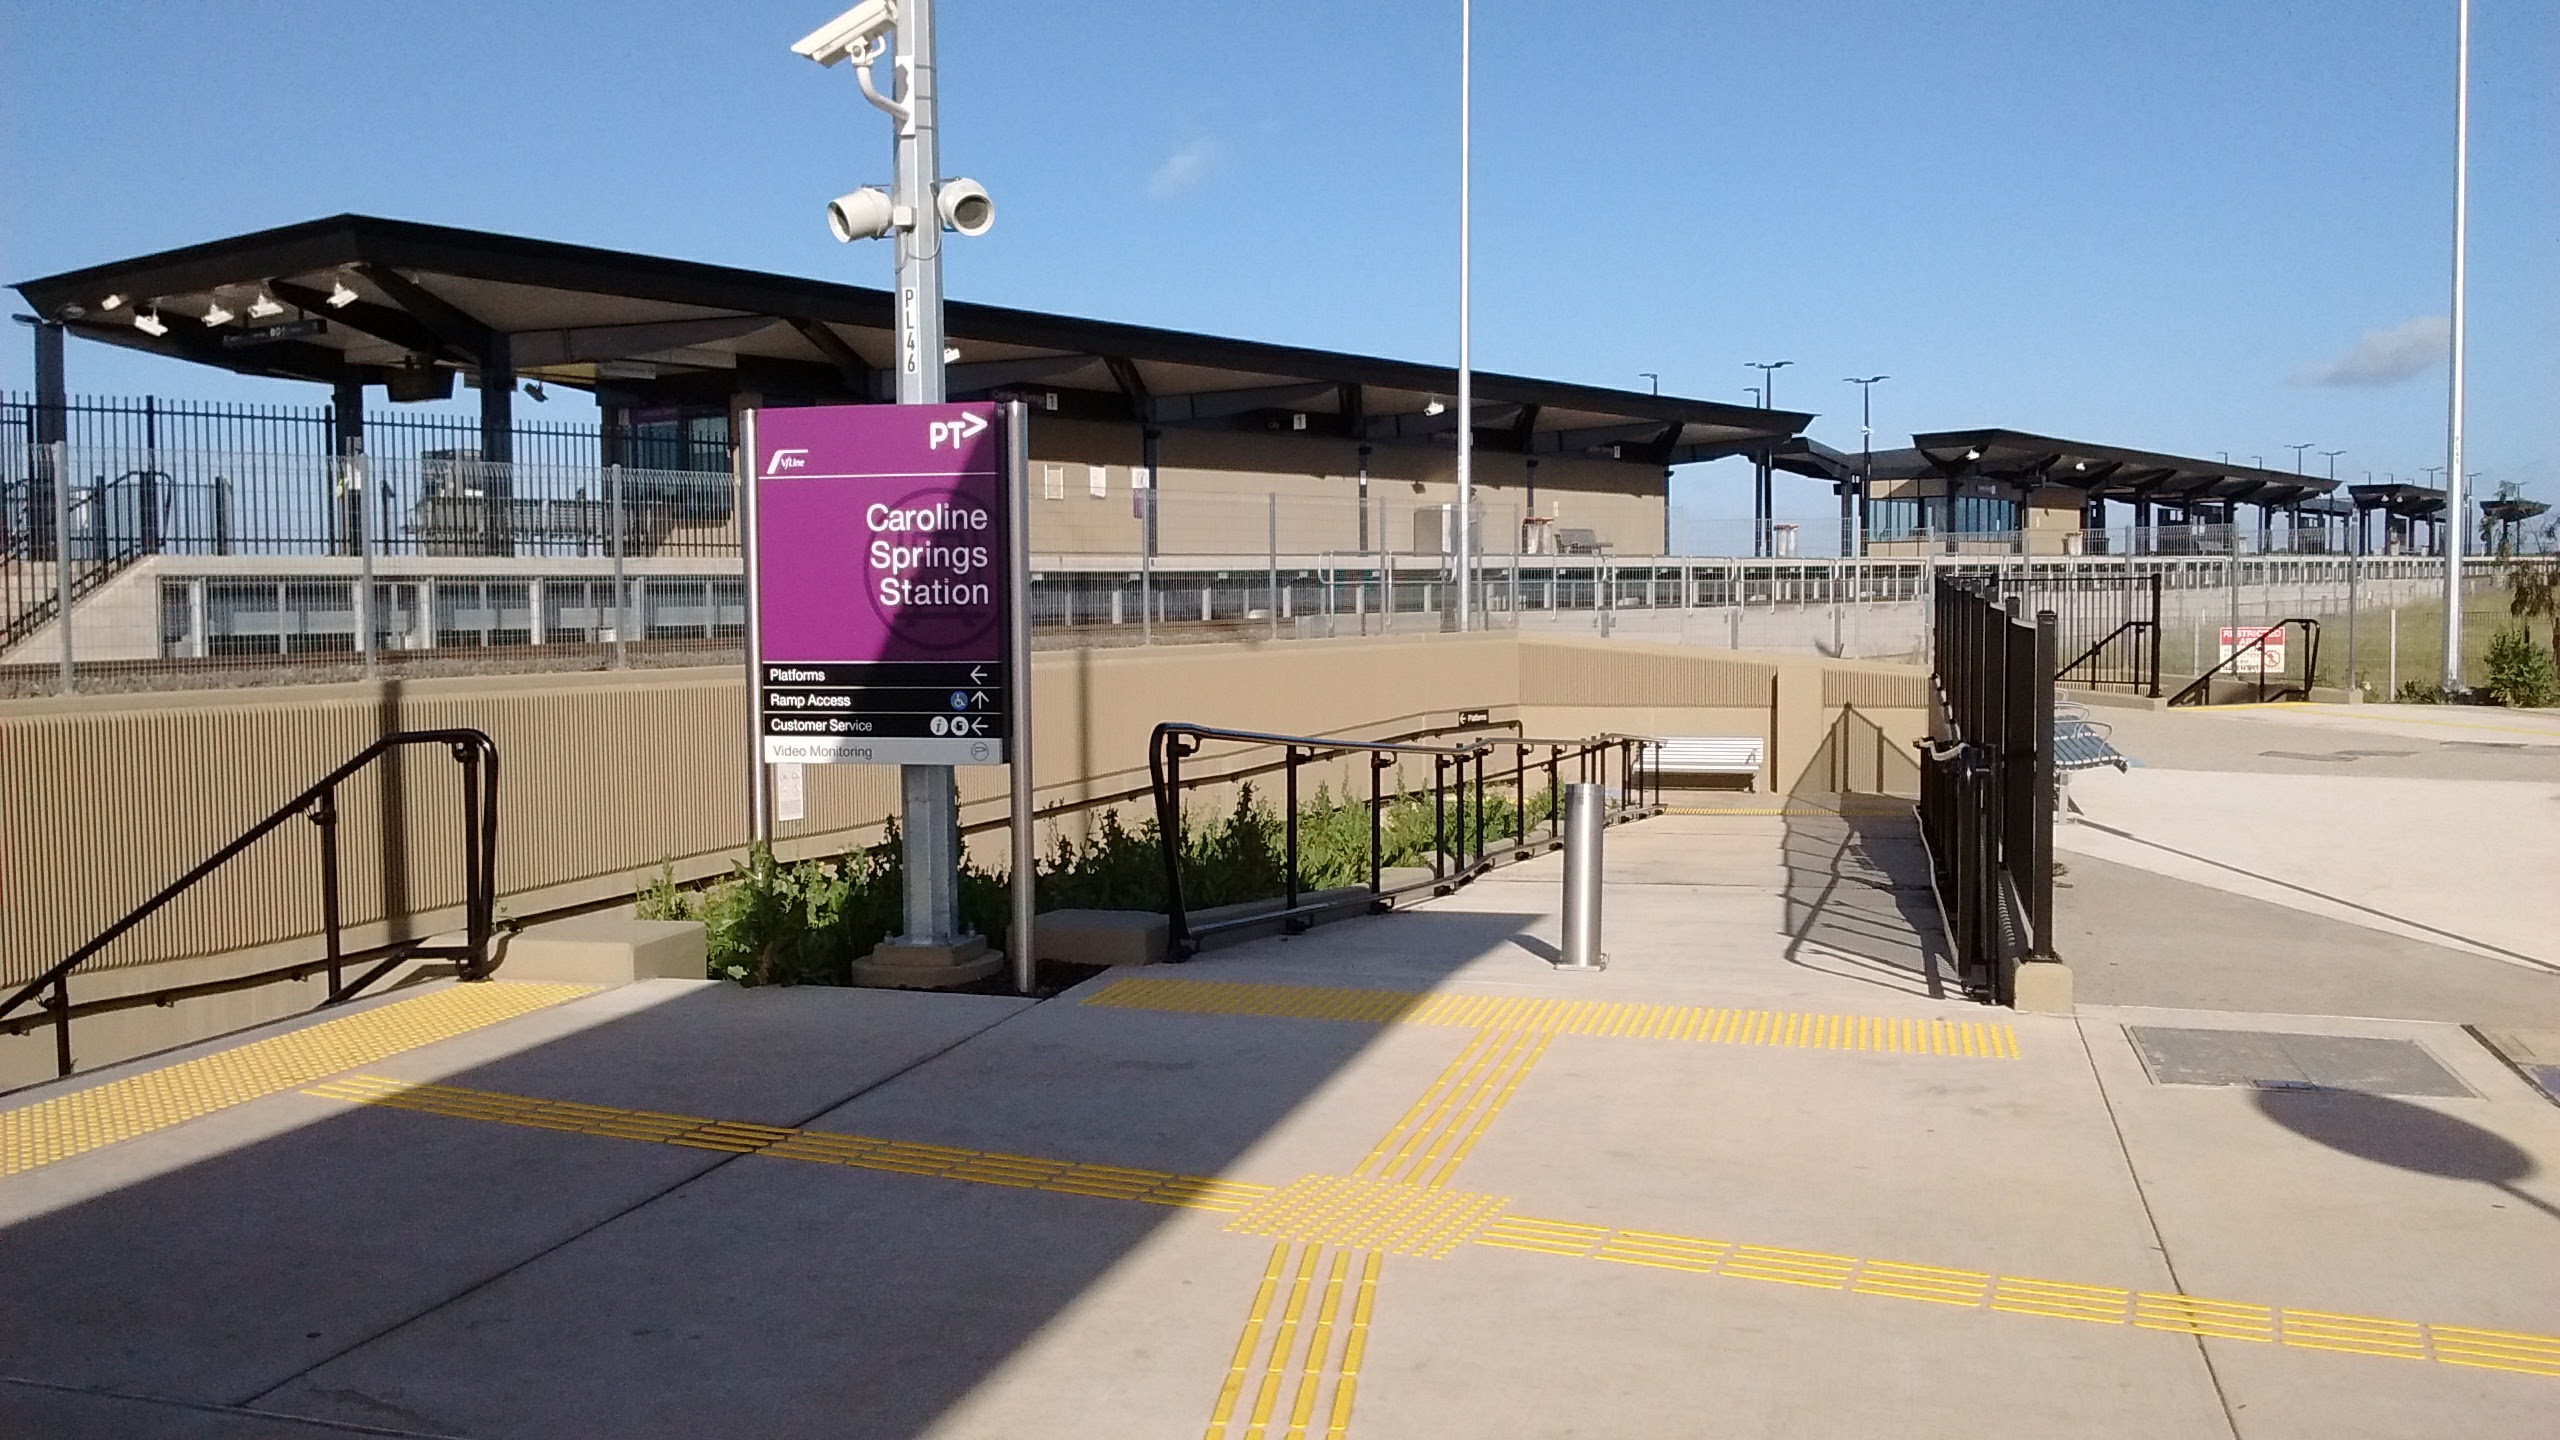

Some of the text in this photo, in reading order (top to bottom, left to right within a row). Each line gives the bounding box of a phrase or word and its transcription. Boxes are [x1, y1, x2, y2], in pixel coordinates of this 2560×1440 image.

[905, 289, 915, 372] PL46
[866, 503, 988, 532] Caroline
[870, 541, 988, 575] Springs
[880, 577, 989, 605] Station
[2223, 629, 2281, 638] RSTRICED
[770, 668, 825, 682] Platforms
[770, 693, 851, 708] Ramp Access
[771, 718, 873, 732] Customer Service
[773, 745, 873, 760] Video Monitoring
